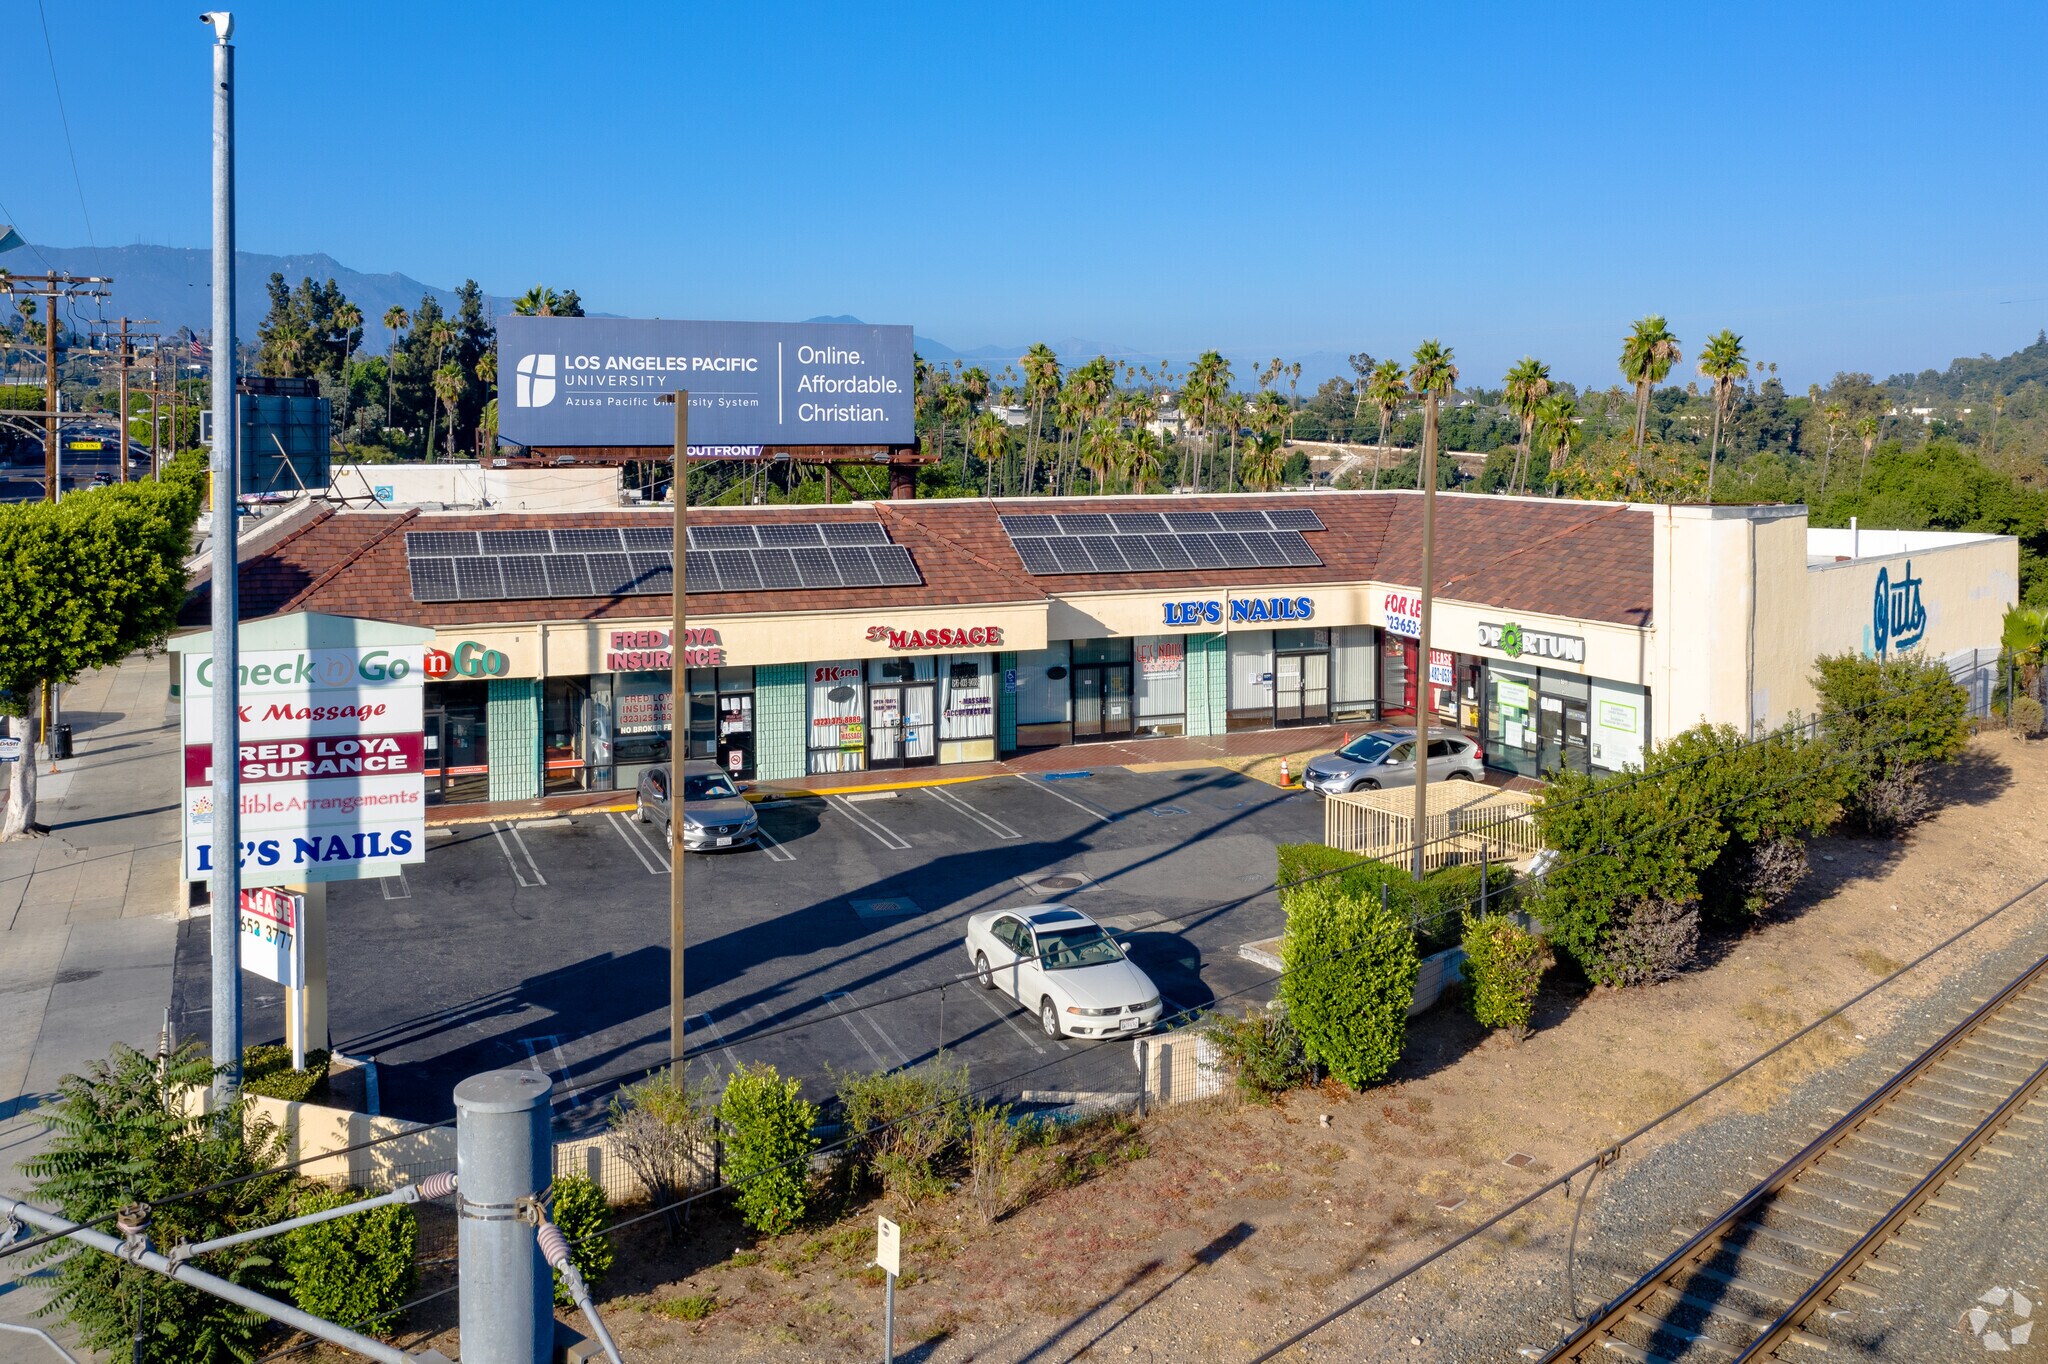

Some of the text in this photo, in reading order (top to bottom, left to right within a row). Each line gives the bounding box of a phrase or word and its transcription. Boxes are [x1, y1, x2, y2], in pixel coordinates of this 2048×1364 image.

[565, 355, 758, 372] LOS ANGELES PACIFIC
[797, 345, 865, 364] Online.
[565, 375, 666, 387] UNIVERSITY
[797, 374, 902, 394] Affordable.
[566, 396, 759, 409] Azusa Pacific Ursity System
[798, 403, 889, 422] Christian.
[1164, 596, 1312, 625] LE'S NAILS
[1385, 594, 1408, 615] FOR
[611, 630, 663, 649] FRED
[865, 625, 1000, 649] SK MASSAGE
[454, 640, 501, 677] Go
[1432, 651, 1452, 667] LEASE
[196, 653, 316, 688] Ceck
[359, 650, 410, 682] Go
[814, 666, 859, 683] SK SPA
[624, 694, 672, 703] FRED LOY
[963, 696, 990, 704] MASSAGE
[238, 703, 386, 722] K Massage
[622, 703, 672, 714] INSURANC
[632, 725, 663, 734] BROKER
[814, 718, 831, 727] (323)
[240, 737, 401, 761] RED LOYA
[204, 755, 408, 782] ISURANCE
[239, 790, 418, 815] dible Arrangements
[196, 829, 413, 871] L'S NAILS
[248, 887, 292, 922] LEASE
